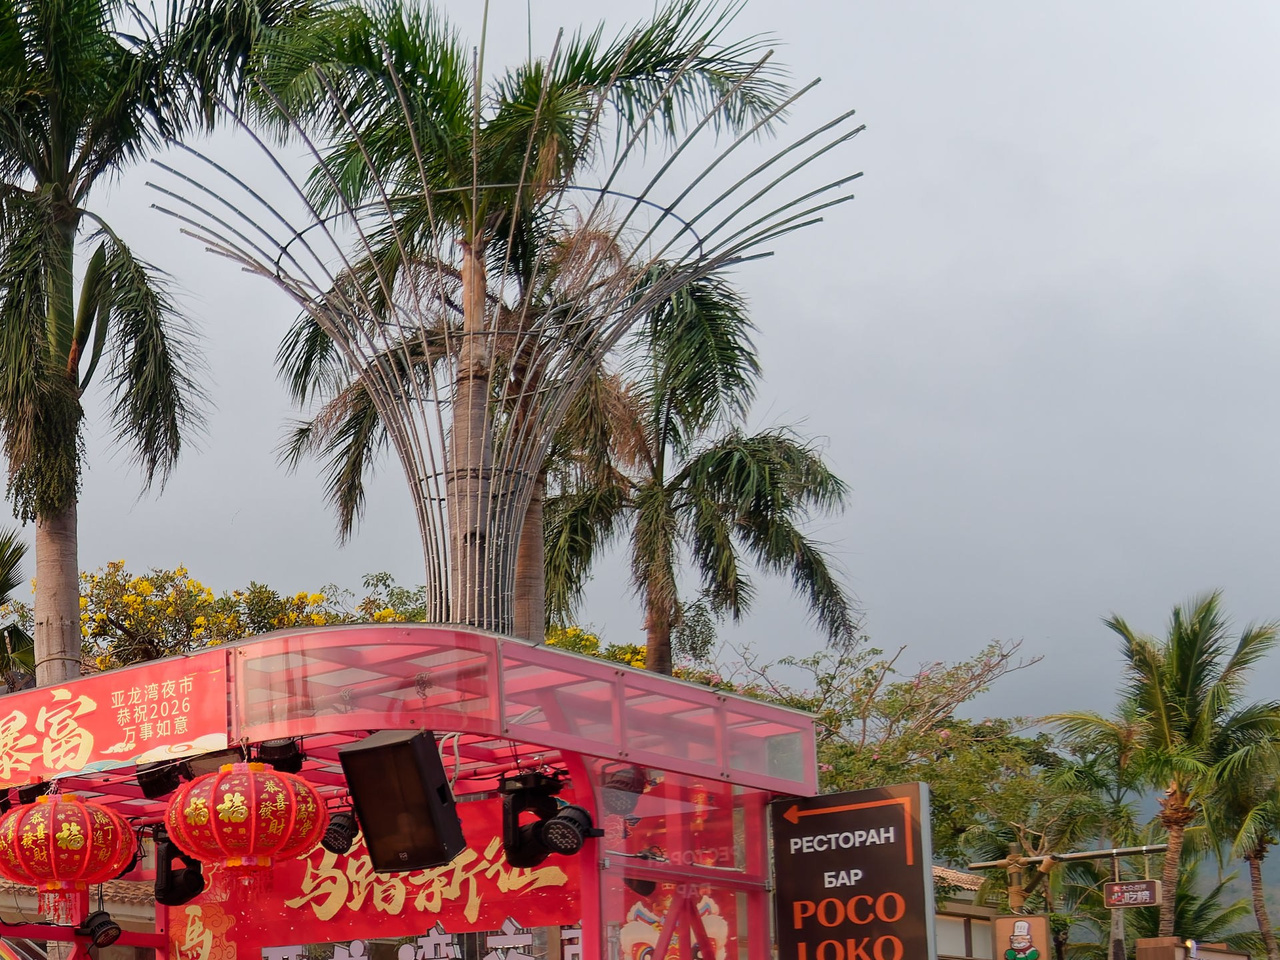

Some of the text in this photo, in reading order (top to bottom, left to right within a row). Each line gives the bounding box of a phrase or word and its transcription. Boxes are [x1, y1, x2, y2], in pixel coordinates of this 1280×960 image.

[111, 676, 194, 708] 亚龙湾夜市
[117, 698, 190, 726] 恭祝2026
[123, 716, 188, 743] 万事如意
[216, 792, 249, 823] 福
[56, 822, 84, 850] 福
[790, 826, 895, 854] РЕСТОРАН
[824, 869, 862, 888] БАР
[793, 892, 906, 930] POCO
